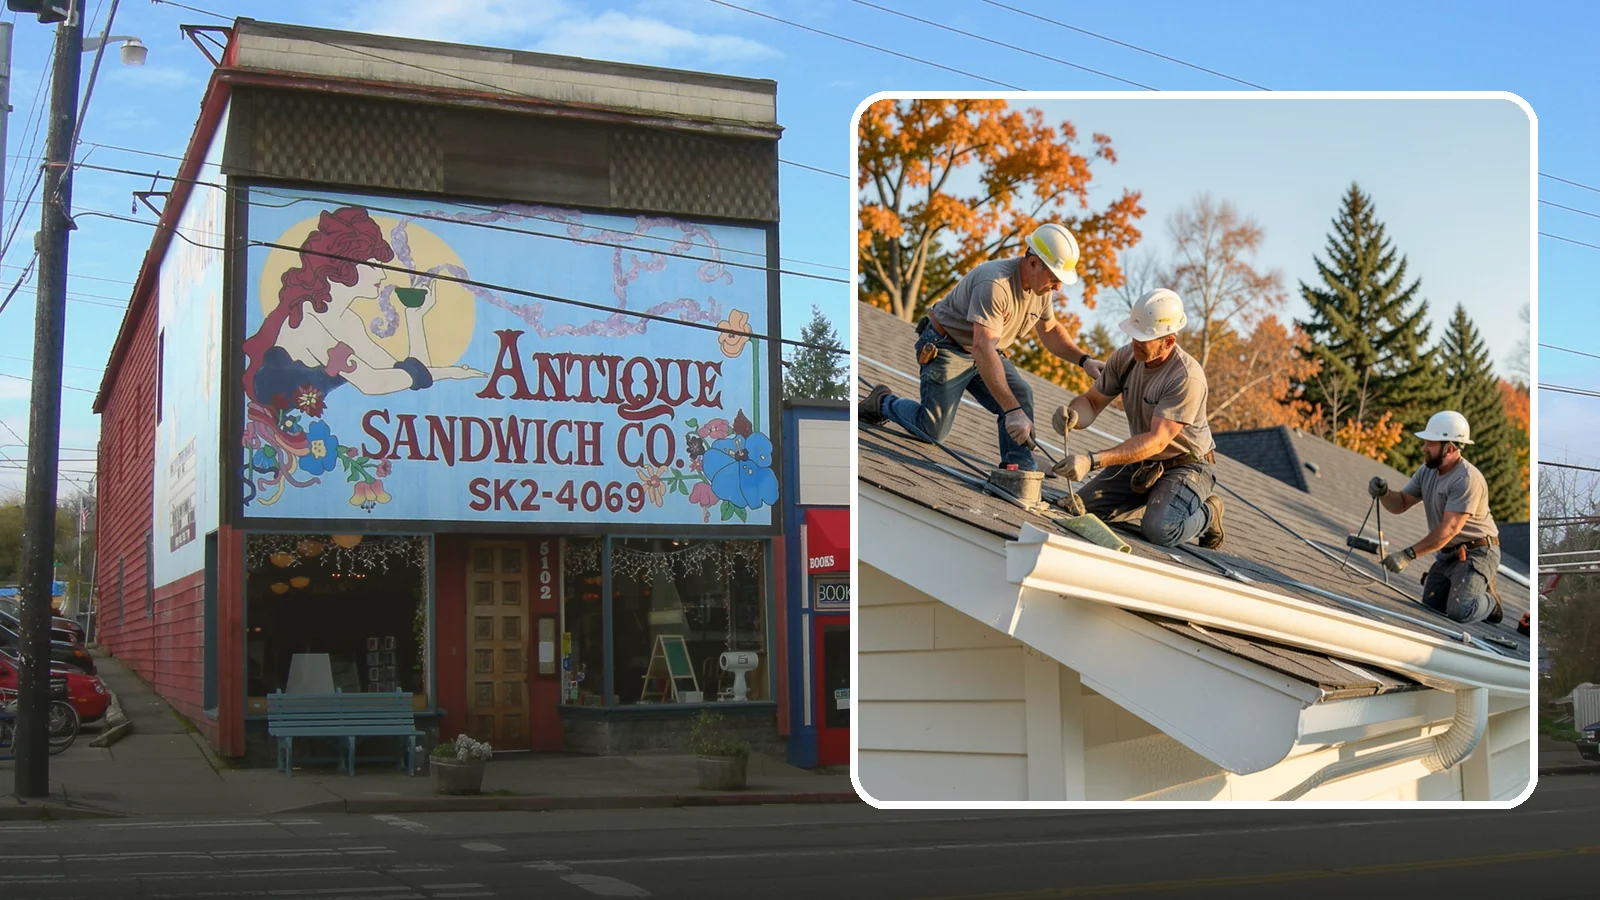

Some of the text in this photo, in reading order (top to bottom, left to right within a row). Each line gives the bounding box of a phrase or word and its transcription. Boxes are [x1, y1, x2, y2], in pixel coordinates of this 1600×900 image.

[476, 329, 723, 420] ANTIQUE
[361, 408, 685, 469] SANDWICH CO.
[469, 477, 646, 513] SK2-4069
[540, 541, 551, 600] 5102
[809, 555, 835, 569] BOOKS
